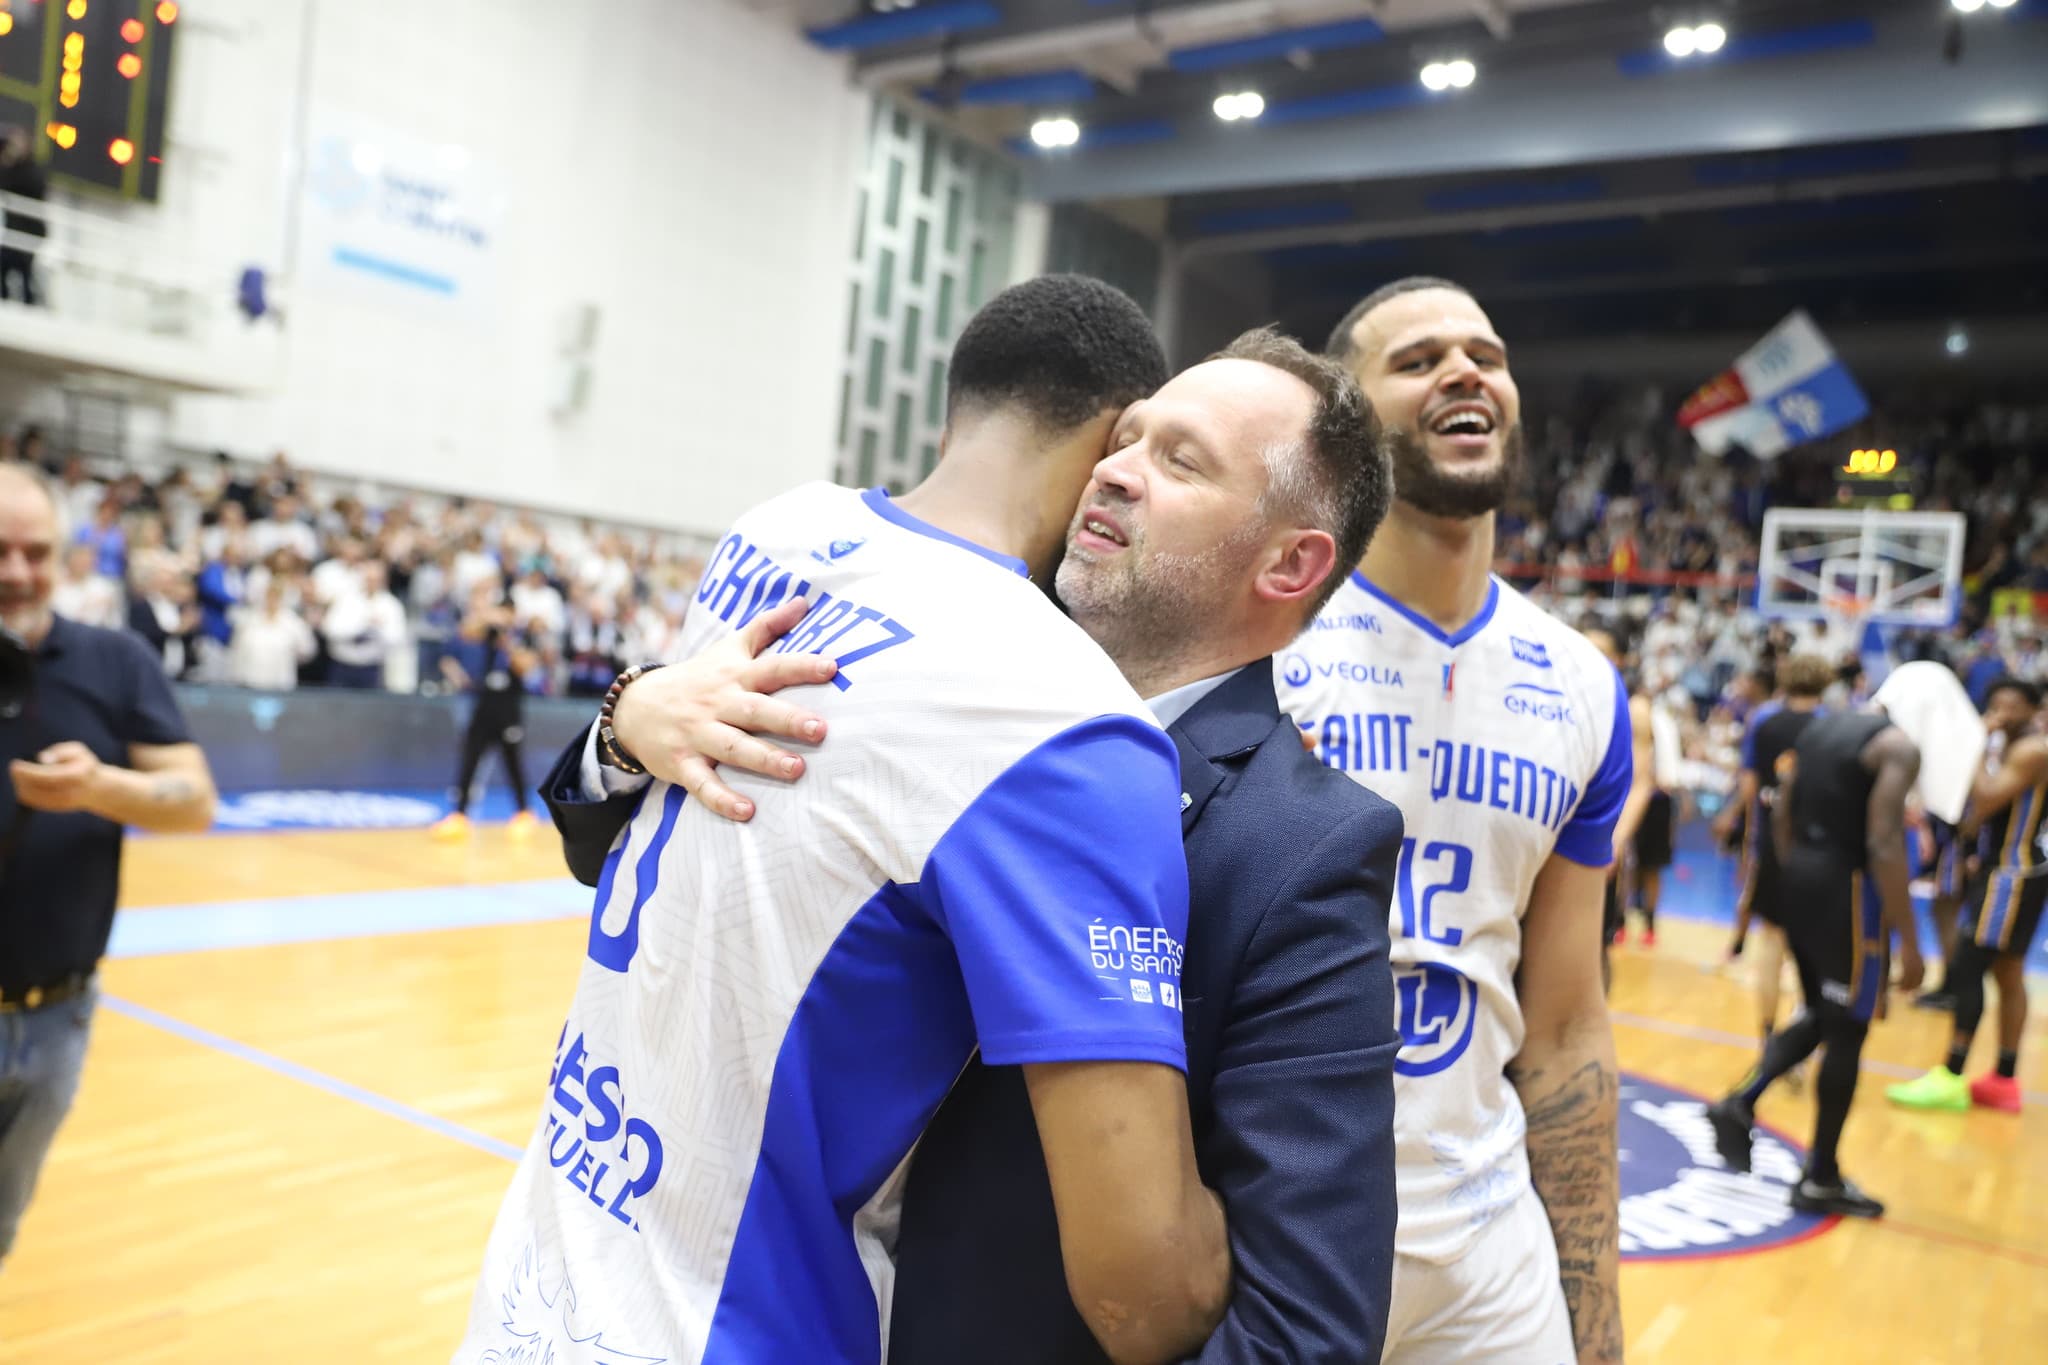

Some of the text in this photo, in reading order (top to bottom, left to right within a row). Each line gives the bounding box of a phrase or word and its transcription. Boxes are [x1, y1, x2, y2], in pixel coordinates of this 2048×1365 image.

[698, 529, 915, 692] CHWARTZ
[1317, 661, 1404, 689] VEOLIA
[1091, 952, 1125, 970] DU
